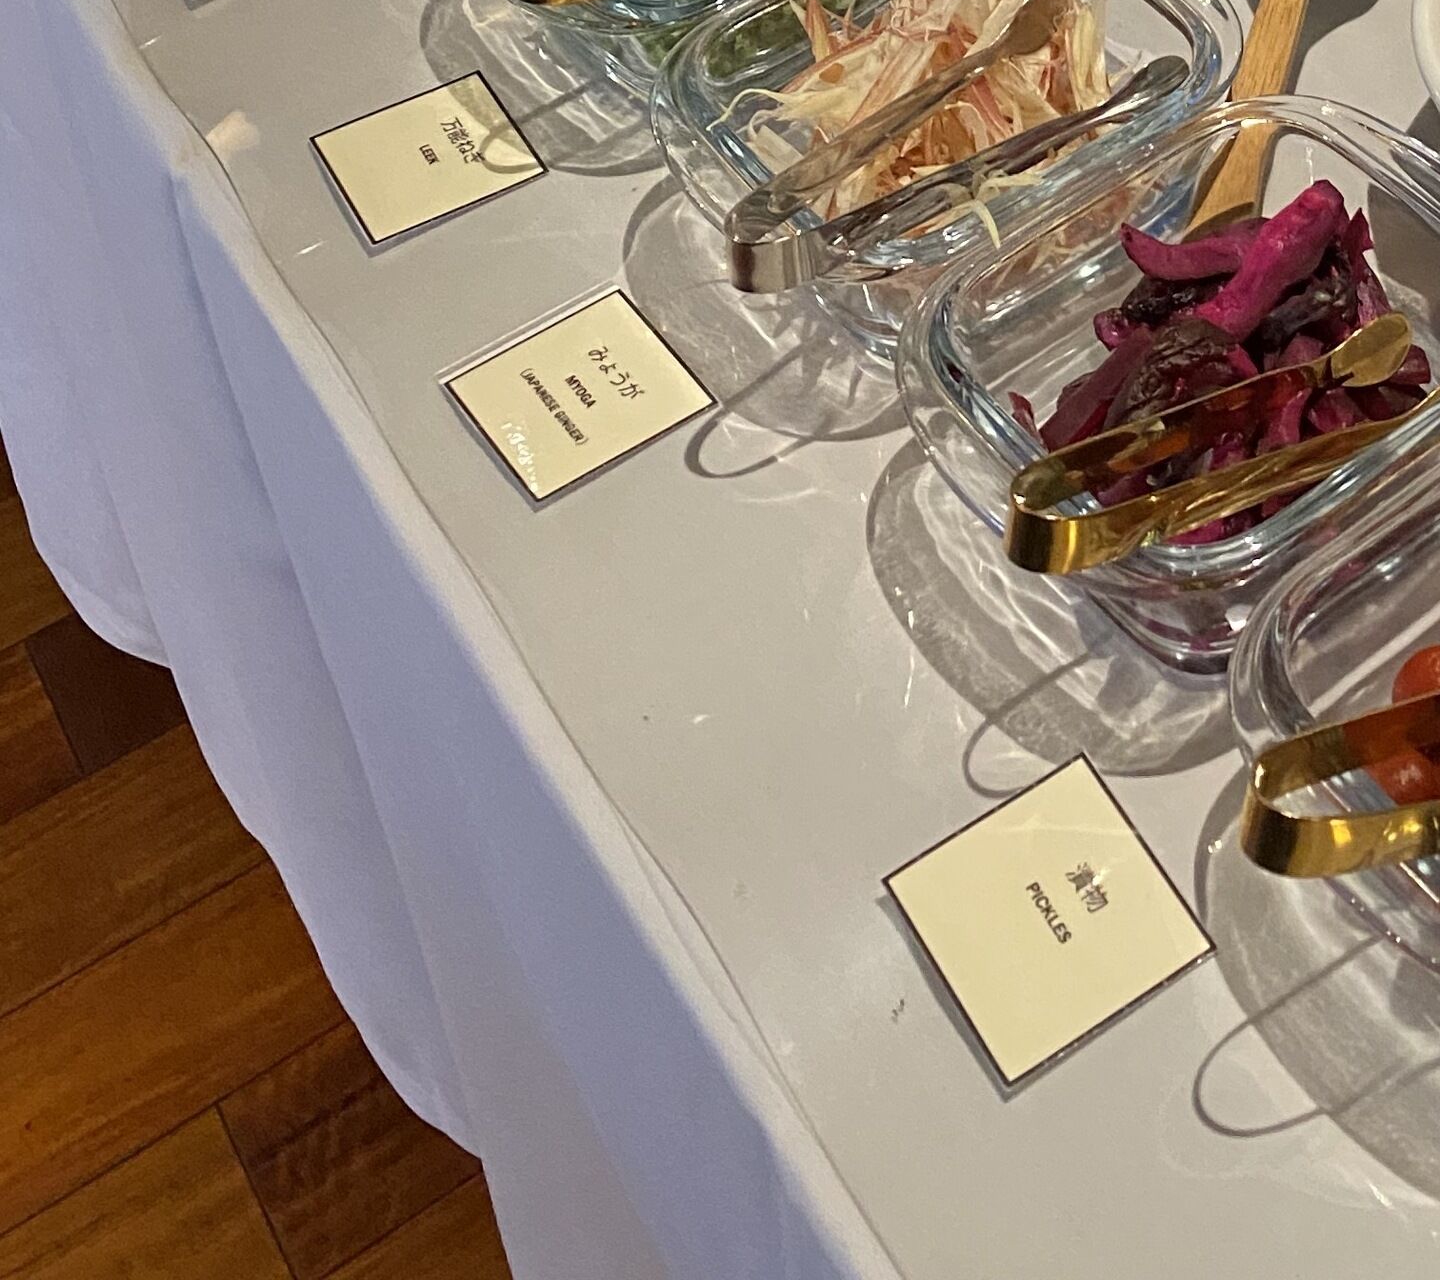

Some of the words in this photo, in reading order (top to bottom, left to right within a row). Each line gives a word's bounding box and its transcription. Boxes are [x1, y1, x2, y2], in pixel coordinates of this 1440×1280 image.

[419, 144, 440, 165] LEEK
[440, 116, 486, 164] 万能ねぎ
[565, 375, 596, 409] MYOGA
[588, 345, 645, 399] みょうが
[519, 368, 560, 413] (JAPANESE
[554, 410, 589, 446] GINGER)
[1026, 881, 1072, 945] PICKLES
[1065, 862, 1109, 914] 漬物
